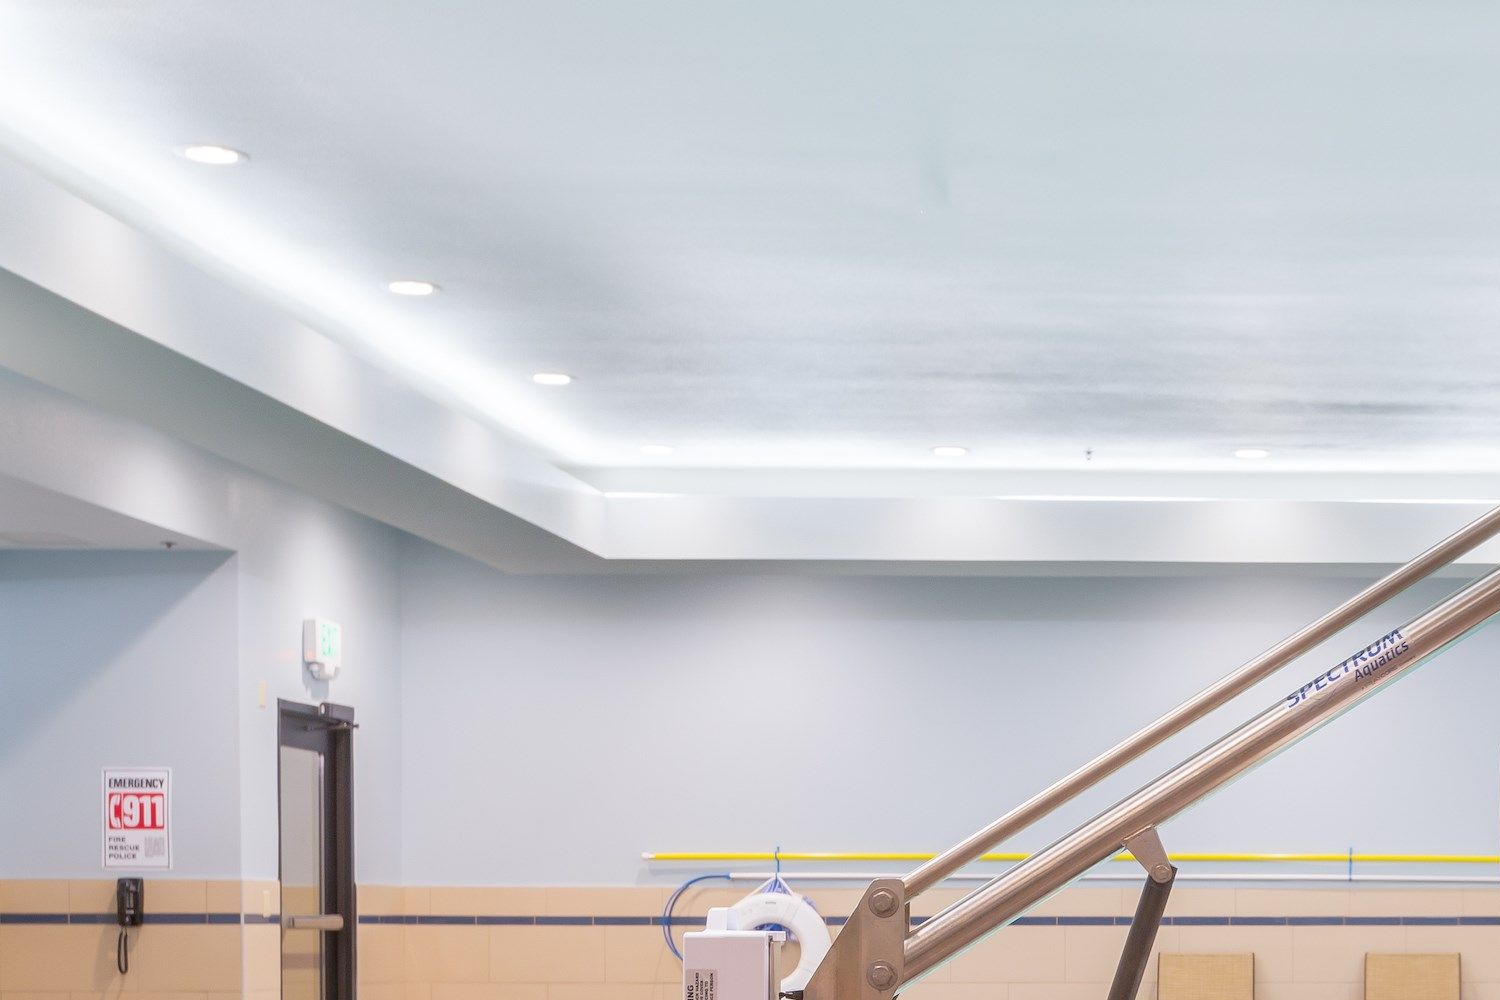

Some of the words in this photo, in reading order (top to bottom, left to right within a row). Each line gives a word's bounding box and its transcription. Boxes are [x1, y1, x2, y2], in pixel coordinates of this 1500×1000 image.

[1286, 627, 1404, 709] SPECTRUM
[1353, 640, 1410, 683] Aquatics
[108, 777, 165, 789] EMERGENCY
[122, 794, 164, 828] 911
